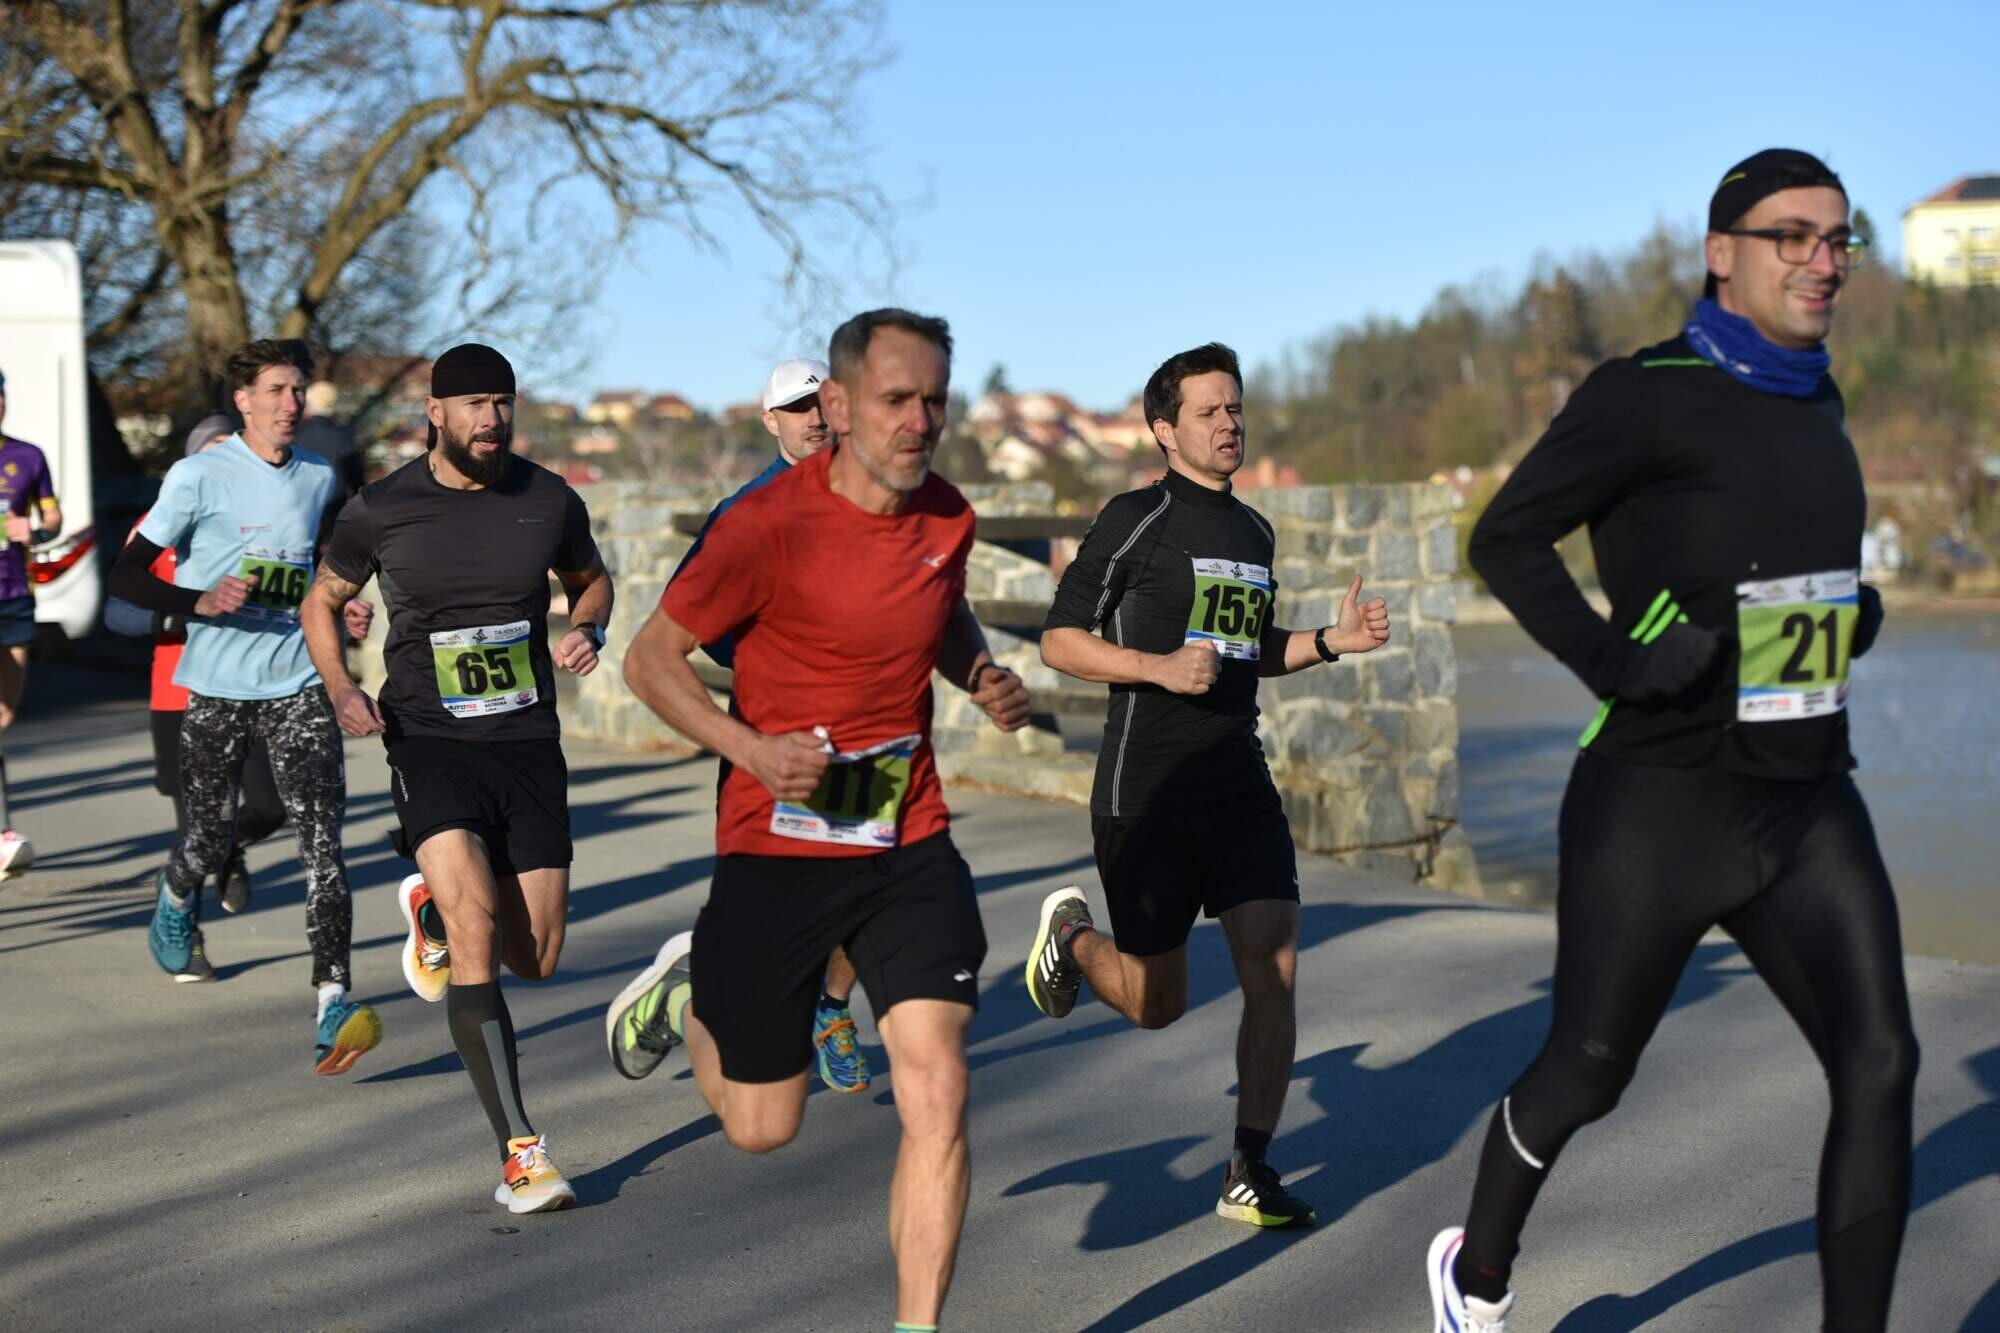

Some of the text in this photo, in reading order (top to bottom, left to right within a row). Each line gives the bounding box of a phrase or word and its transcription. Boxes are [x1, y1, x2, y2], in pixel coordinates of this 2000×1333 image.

[247, 565, 305, 607] 146
[1203, 584, 1266, 638] 153
[456, 647, 517, 695] 65
[1780, 609, 1837, 683] 21
